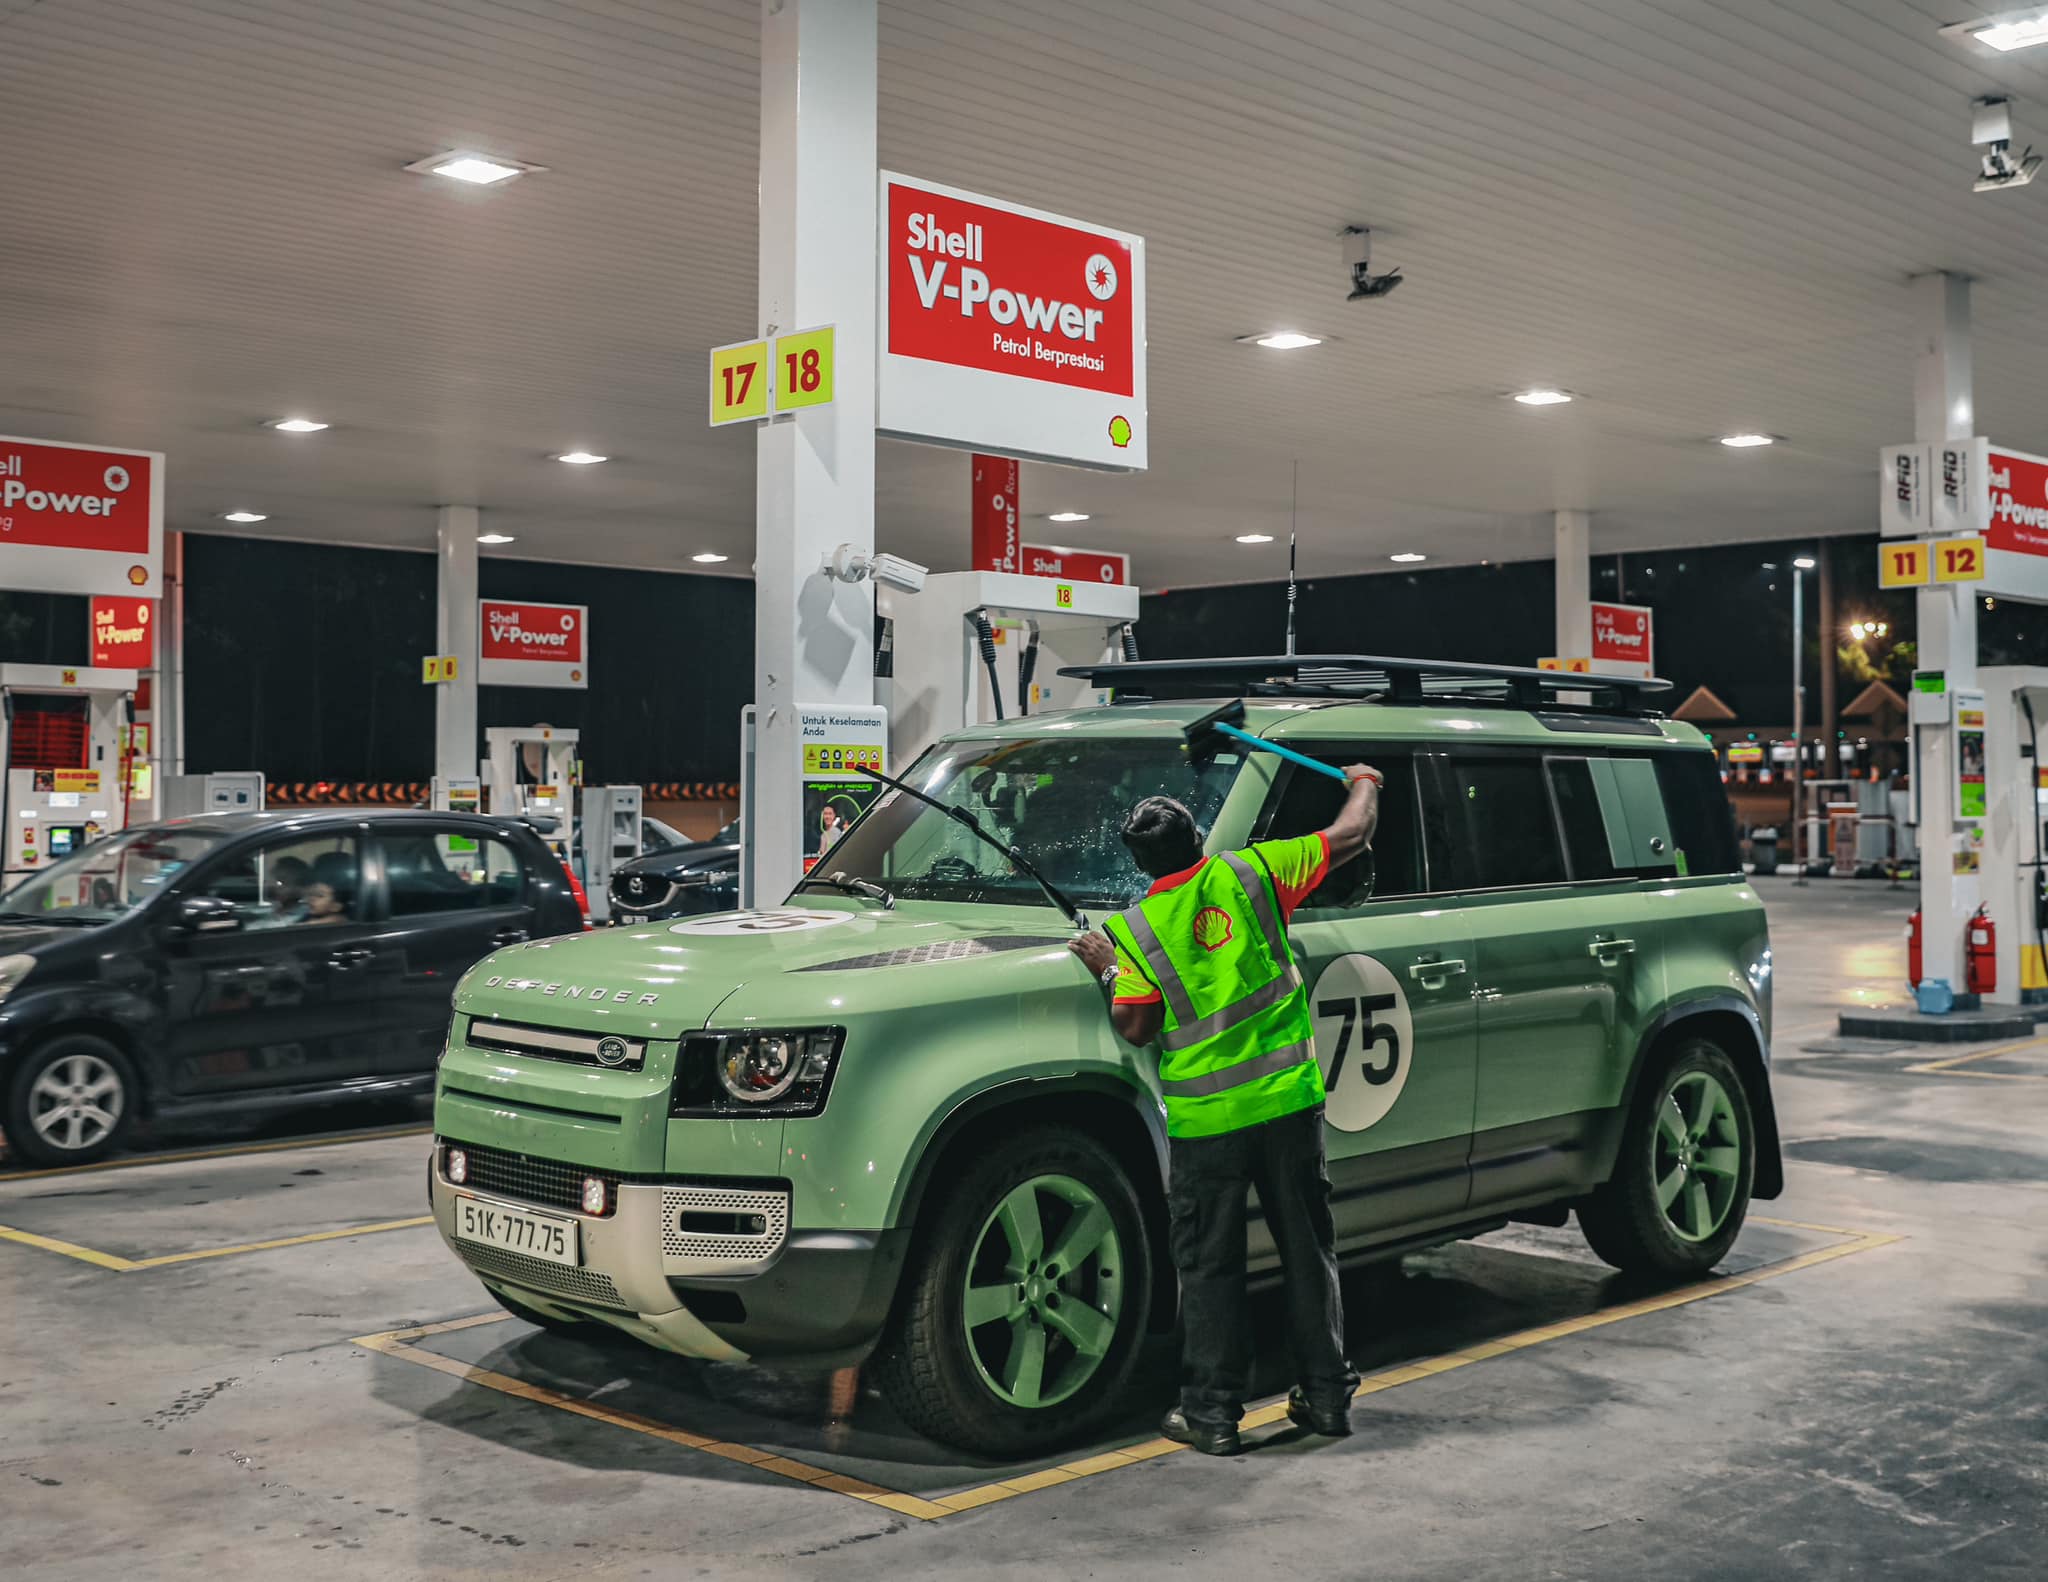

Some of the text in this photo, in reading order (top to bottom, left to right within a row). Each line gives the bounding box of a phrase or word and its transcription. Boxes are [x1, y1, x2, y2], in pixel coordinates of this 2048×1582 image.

[907, 213, 983, 263] Shell
[907, 255, 1104, 342] V-Power
[993, 333, 1104, 371] Petrol Berprestasi
[785, 348, 821, 394] 18
[722, 362, 757, 407] 17
[1033, 557, 1062, 574] Shell
[1893, 552, 1916, 576] 11
[1944, 548, 1976, 573] 12
[1057, 589, 1070, 603] 18
[489, 611, 519, 625] Shell
[489, 625, 569, 647] V-Power
[63, 672, 76, 684] 16
[429, 662, 437, 676] 7
[802, 716, 881, 727] Untuk Keselamatan
[802, 727, 825, 736] Anda
[485, 975, 660, 1006] DEFENDER
[1317, 993, 1399, 1092] 75
